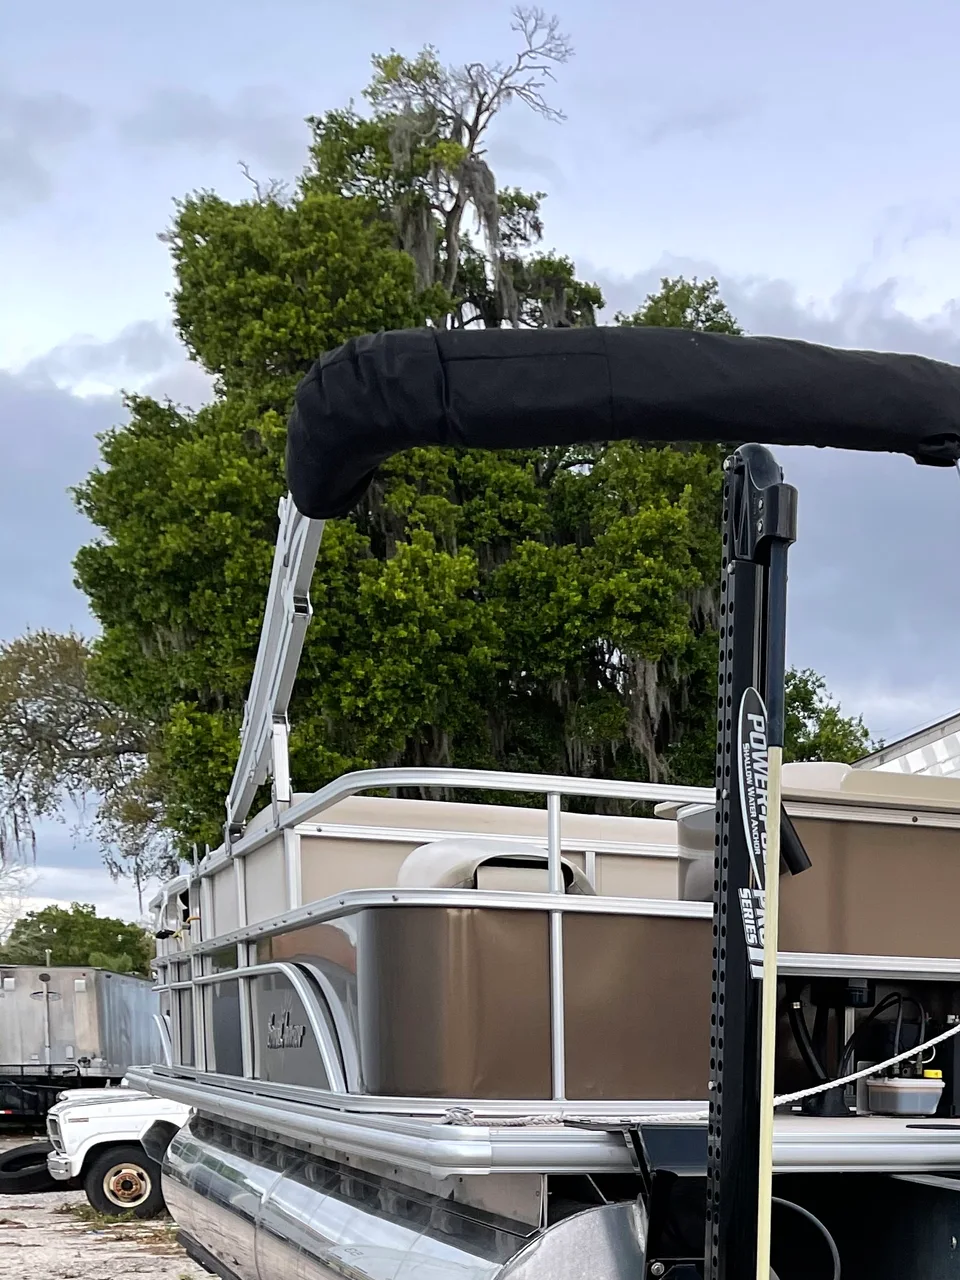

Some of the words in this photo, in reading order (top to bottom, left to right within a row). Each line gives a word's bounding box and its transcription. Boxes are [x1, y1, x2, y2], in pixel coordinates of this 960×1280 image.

[742, 743, 754, 785] SHALLOW
[747, 713, 768, 866] POWER-P
[747, 786, 757, 817] WATER
[751, 819, 761, 855] ANCHOR
[738, 888, 757, 945] SERIES
